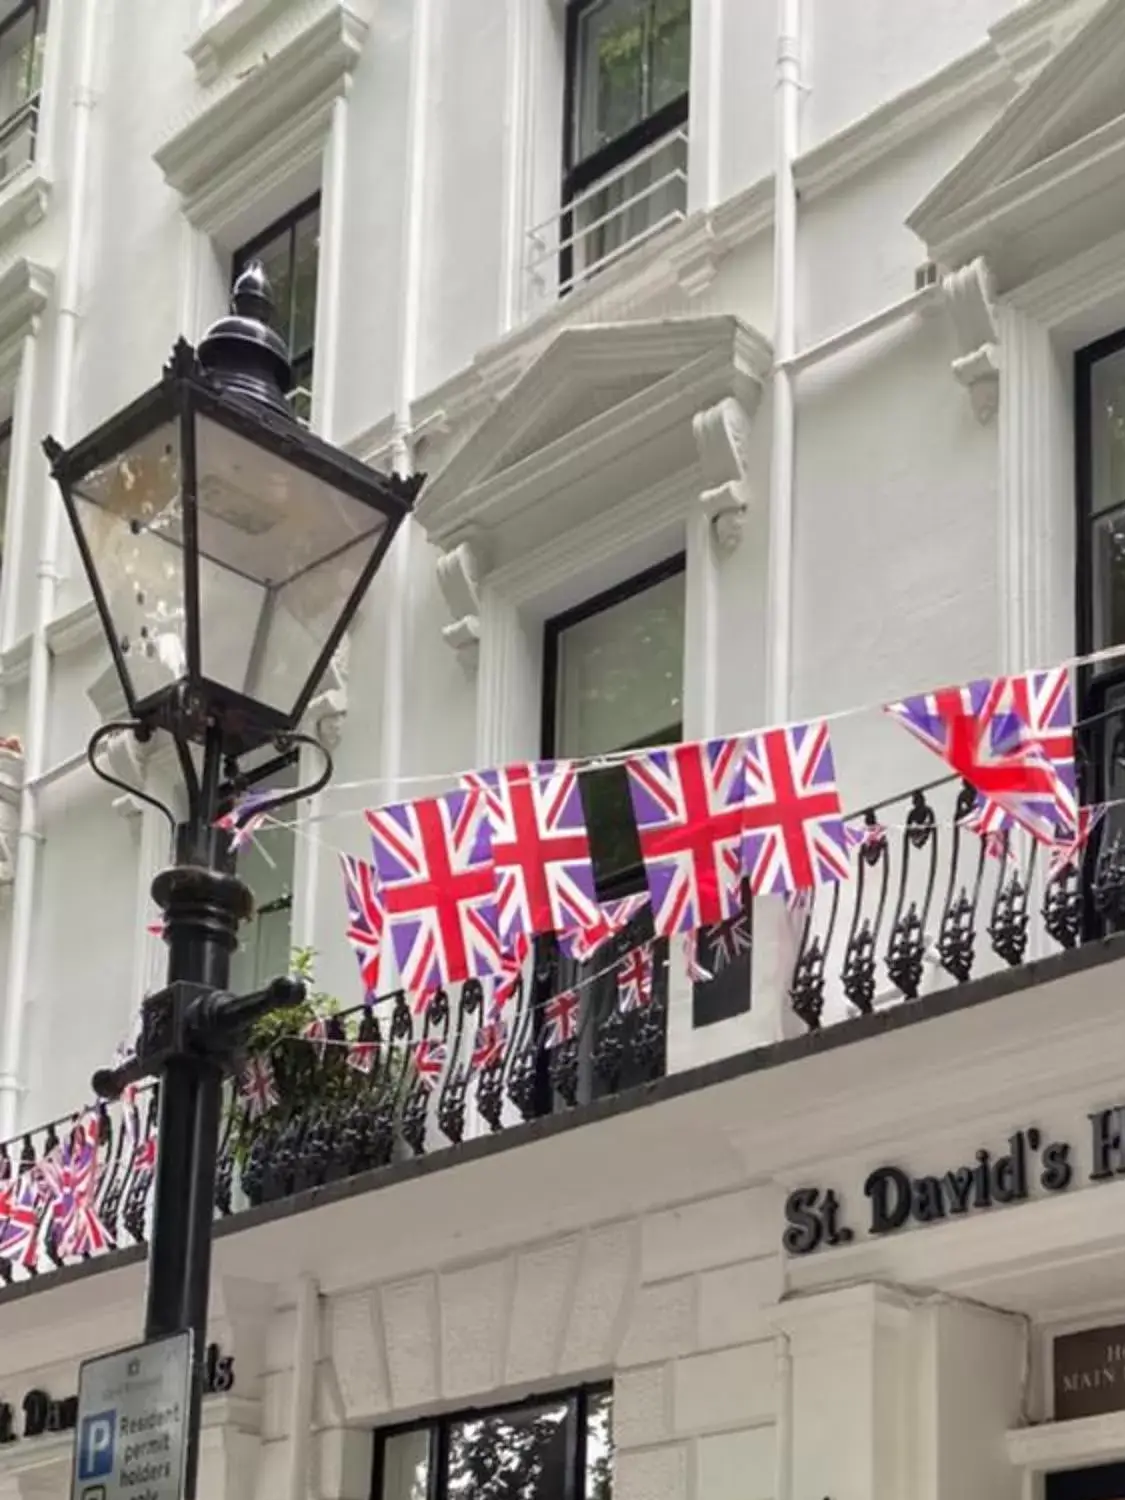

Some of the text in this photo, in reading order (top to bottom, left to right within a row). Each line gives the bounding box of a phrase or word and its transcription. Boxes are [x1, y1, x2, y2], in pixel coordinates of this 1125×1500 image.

[782, 1187, 854, 1255] St.
[863, 1126, 1073, 1236] David's
[1062, 1367, 1115, 1393] MAIN
[119, 1403, 180, 1435] Resident
[86, 1418, 111, 1474] P
[123, 1433, 170, 1464] permit
[119, 1461, 171, 1489] holders
